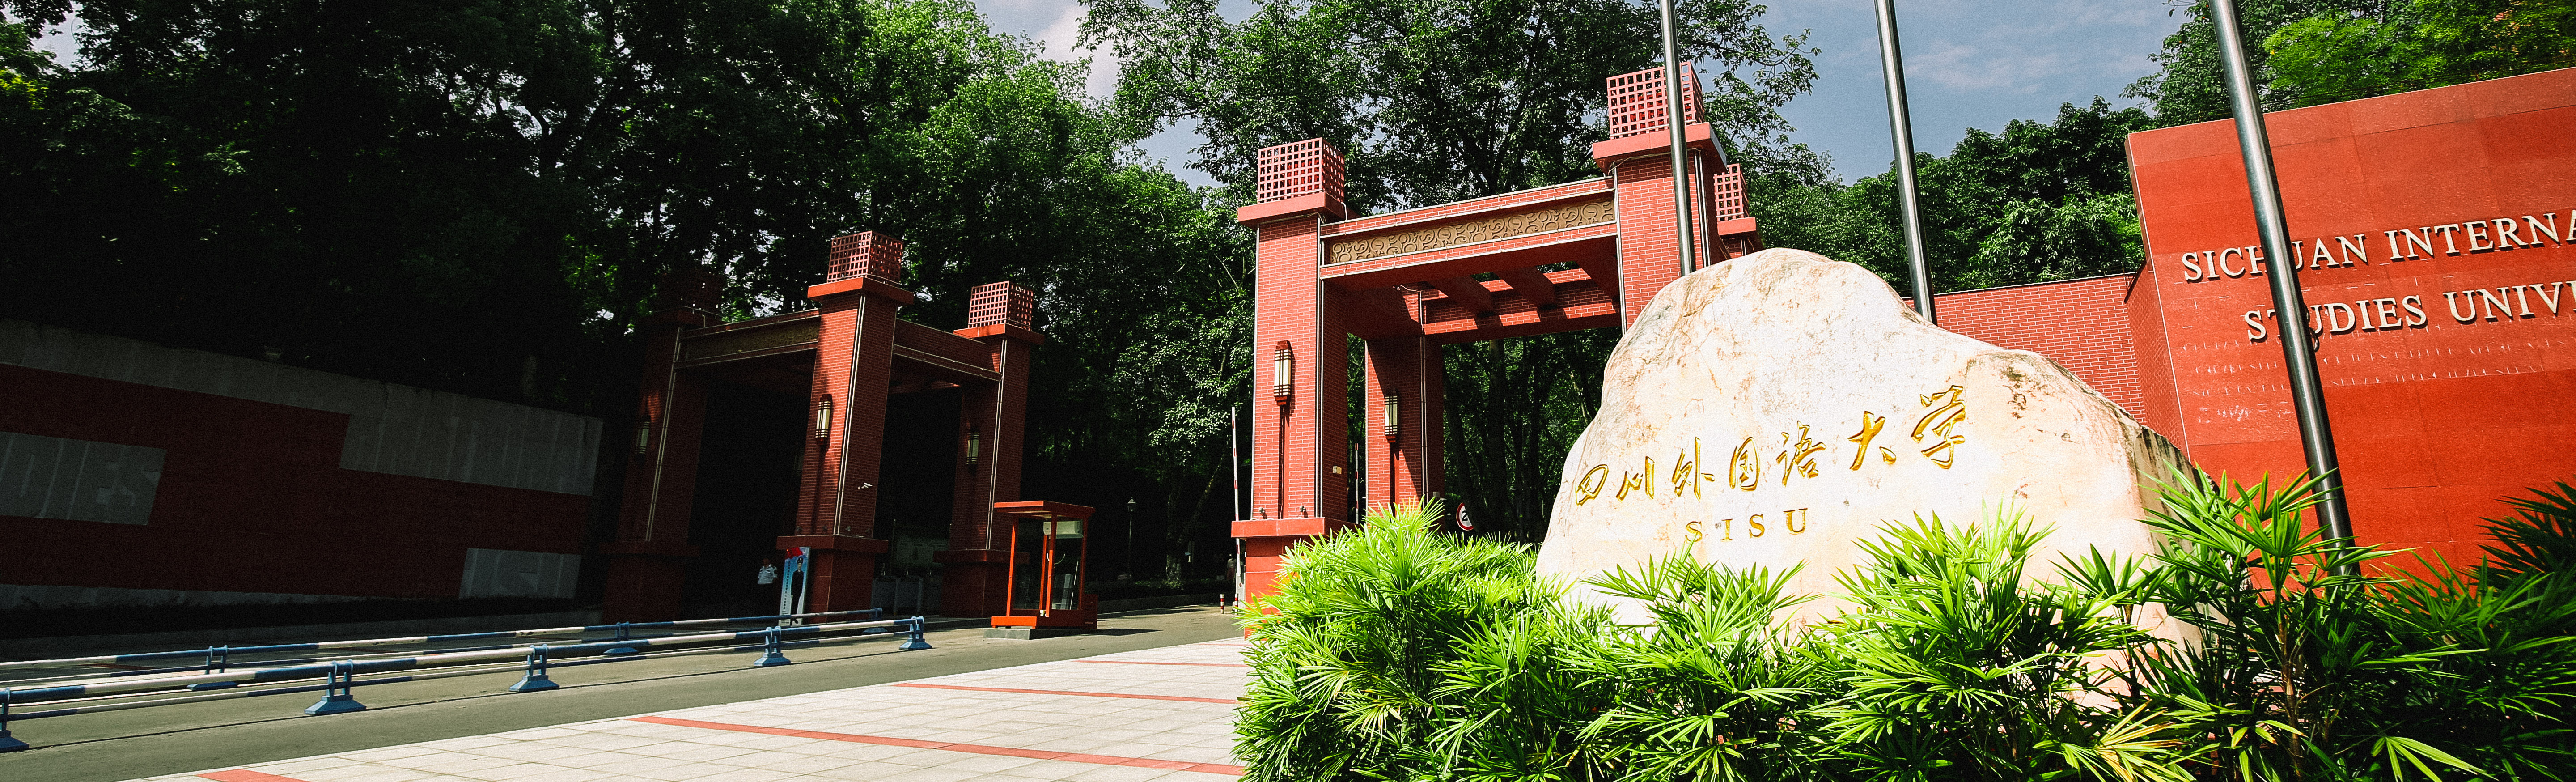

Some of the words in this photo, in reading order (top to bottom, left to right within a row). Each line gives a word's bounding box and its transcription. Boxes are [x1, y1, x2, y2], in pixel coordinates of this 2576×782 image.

[2244, 294, 2428, 341] SDIES
[1575, 385, 1966, 506] 四川外国语大学
[1684, 507, 1808, 543] SISU
